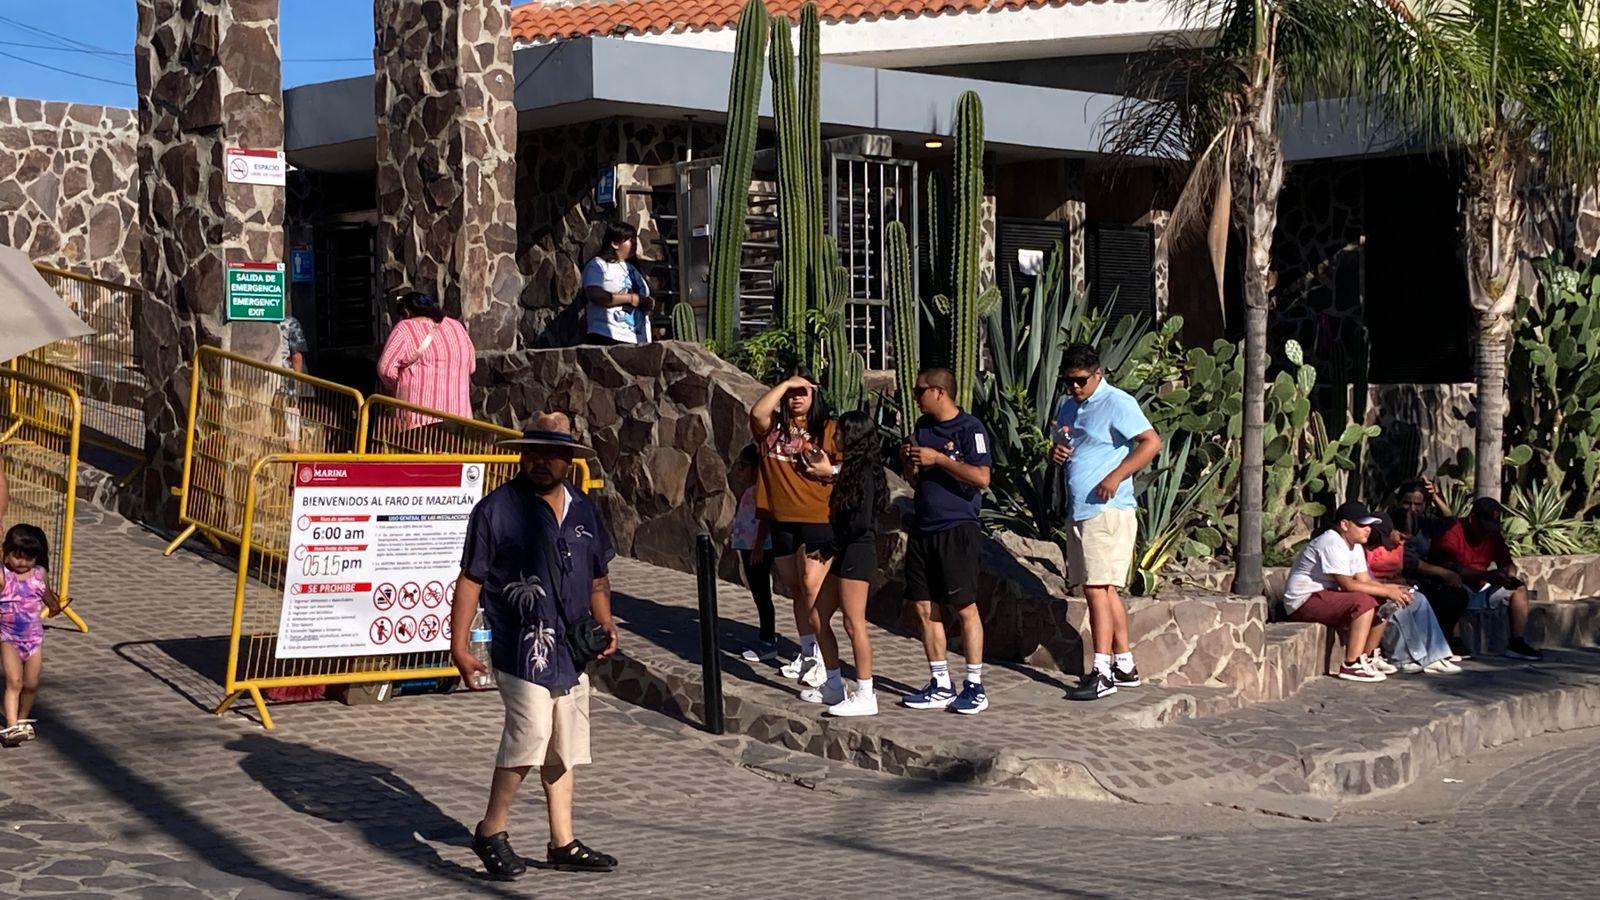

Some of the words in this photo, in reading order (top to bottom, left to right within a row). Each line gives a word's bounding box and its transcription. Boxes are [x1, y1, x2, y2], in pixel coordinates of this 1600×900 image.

[254, 163, 280, 171] ESPACIO
[236, 273, 264, 282] SALIDA
[265, 274, 276, 283] DE
[231, 283, 282, 294] EMERGENCIA
[232, 297, 281, 307] EMERGENCY
[247, 307, 266, 317] EXIT
[313, 469, 348, 478] MARINA
[302, 496, 368, 507] BIENVENIDOS
[370, 496, 382, 506] AL
[385, 496, 409, 506] FARO
[411, 496, 423, 506] DE
[425, 493, 475, 505] MAZATLÁN
[313, 526, 342, 540] 6:00
[344, 529, 365, 540] am
[341, 559, 363, 573] pm
[307, 584, 319, 593] SE
[320, 583, 356, 592] PROHIBE
